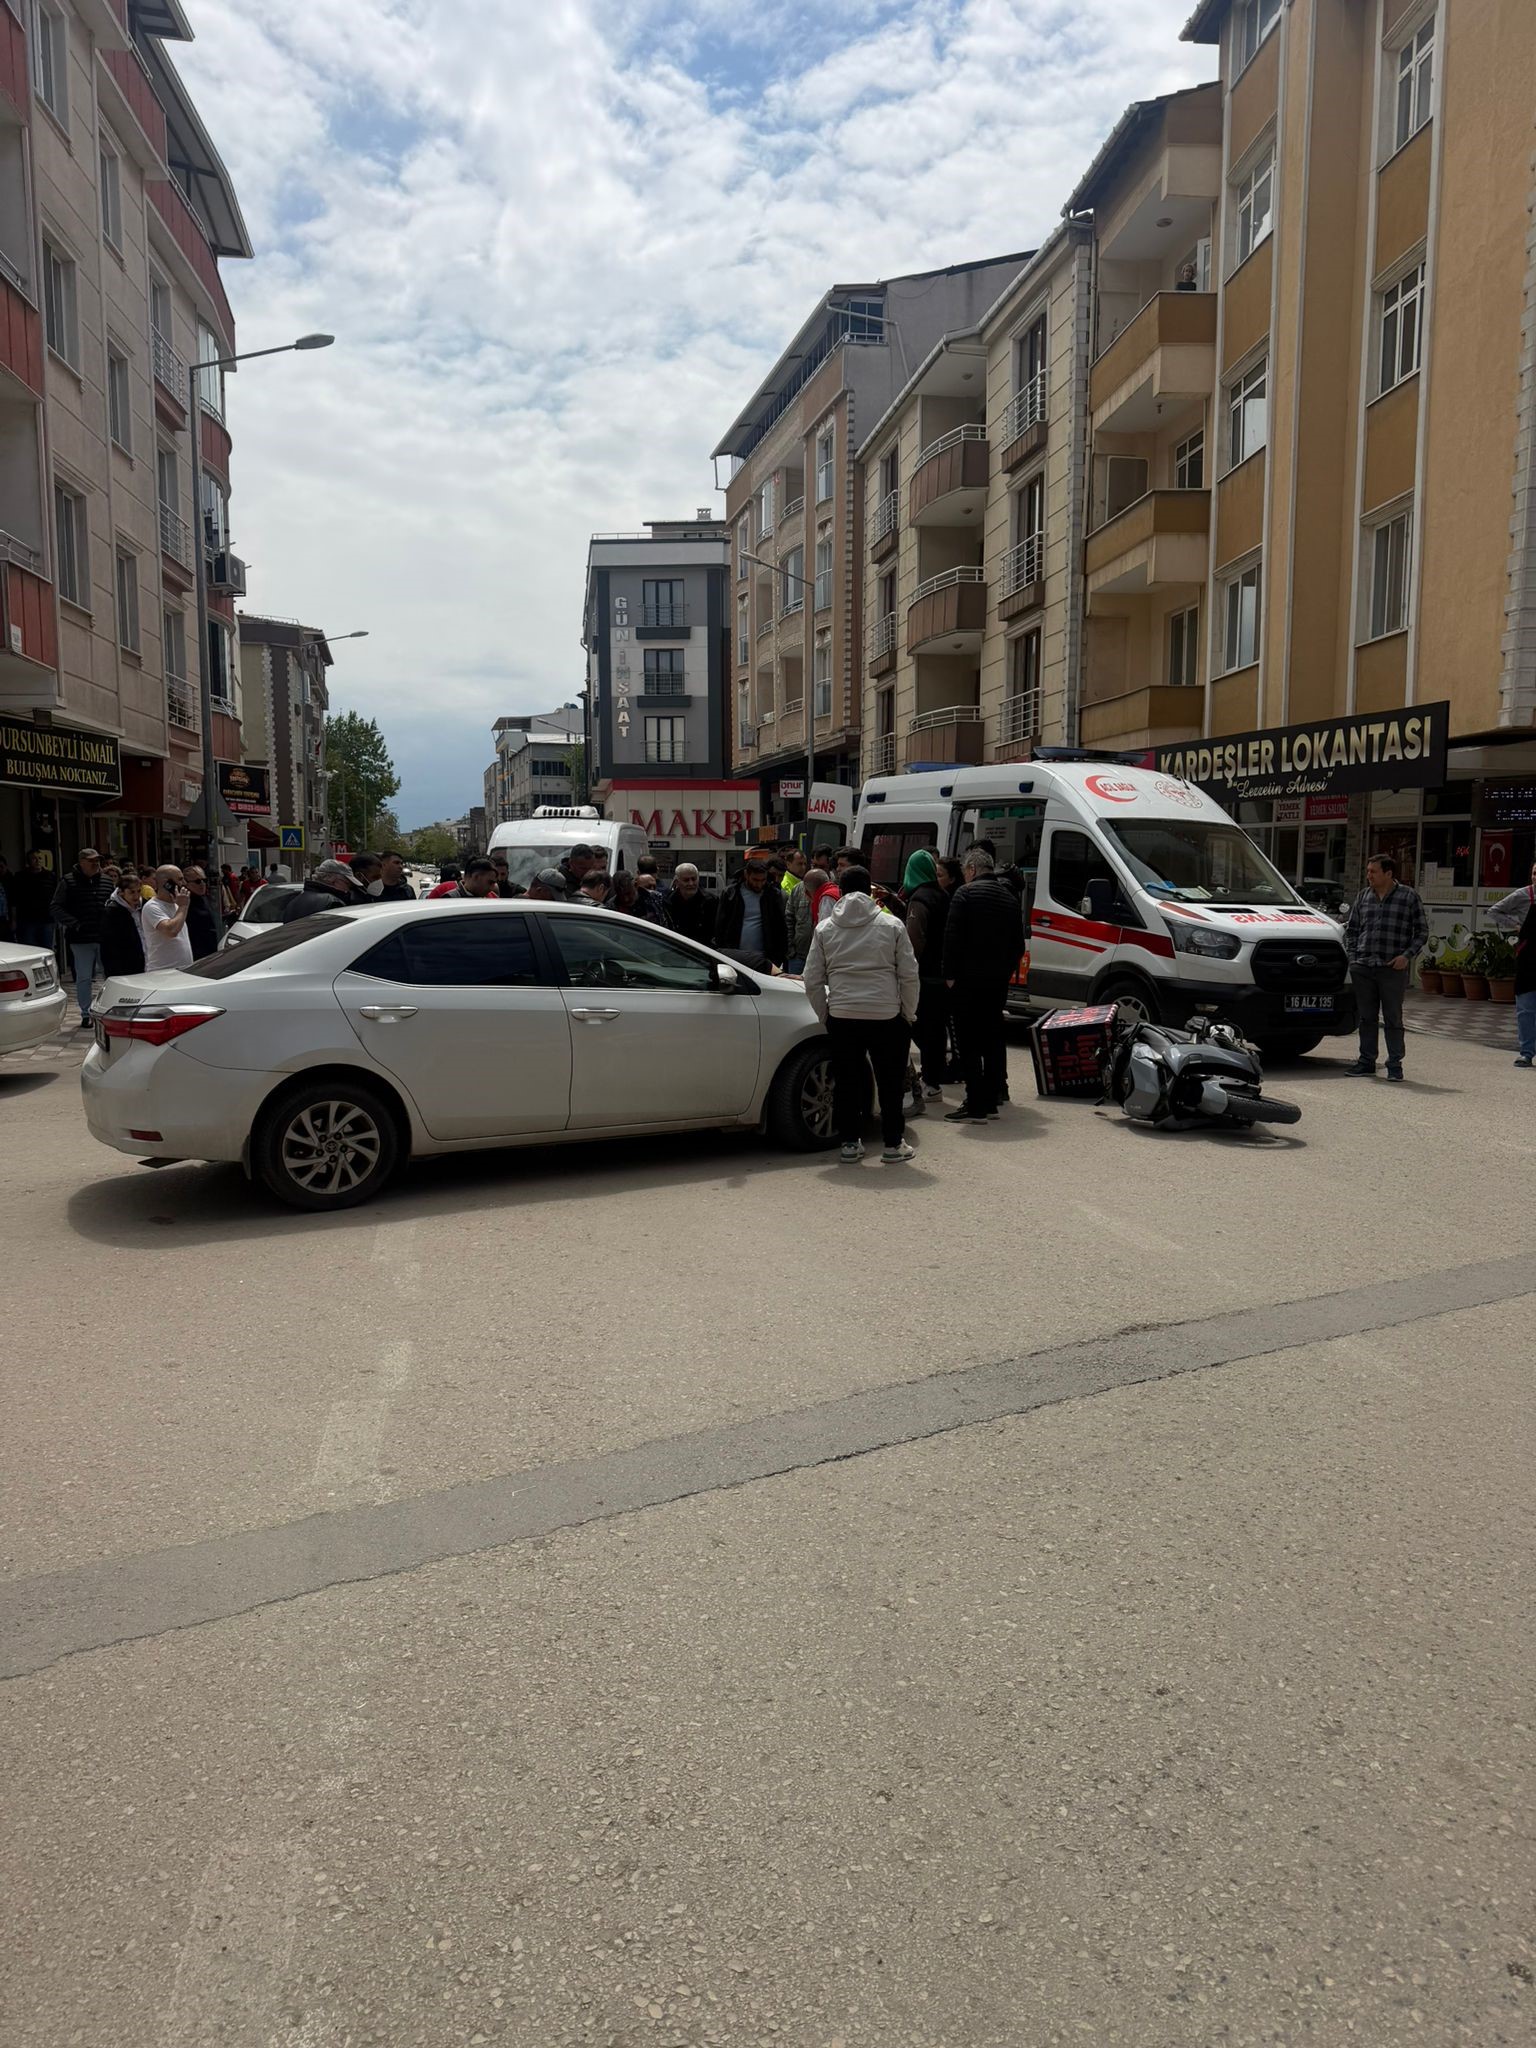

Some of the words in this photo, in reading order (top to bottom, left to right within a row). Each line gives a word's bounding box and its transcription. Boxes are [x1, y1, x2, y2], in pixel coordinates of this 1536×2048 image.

[0, 727, 78, 760] URSUNBEY'Lİ
[1160, 739, 1275, 788] KARDEŞLER
[1281, 716, 1433, 773] LOKANTASI
[6, 759, 58, 781] BULUŞMA
[1290, 997, 1300, 1008] 16
[1301, 997, 1317, 1008] ALZ
